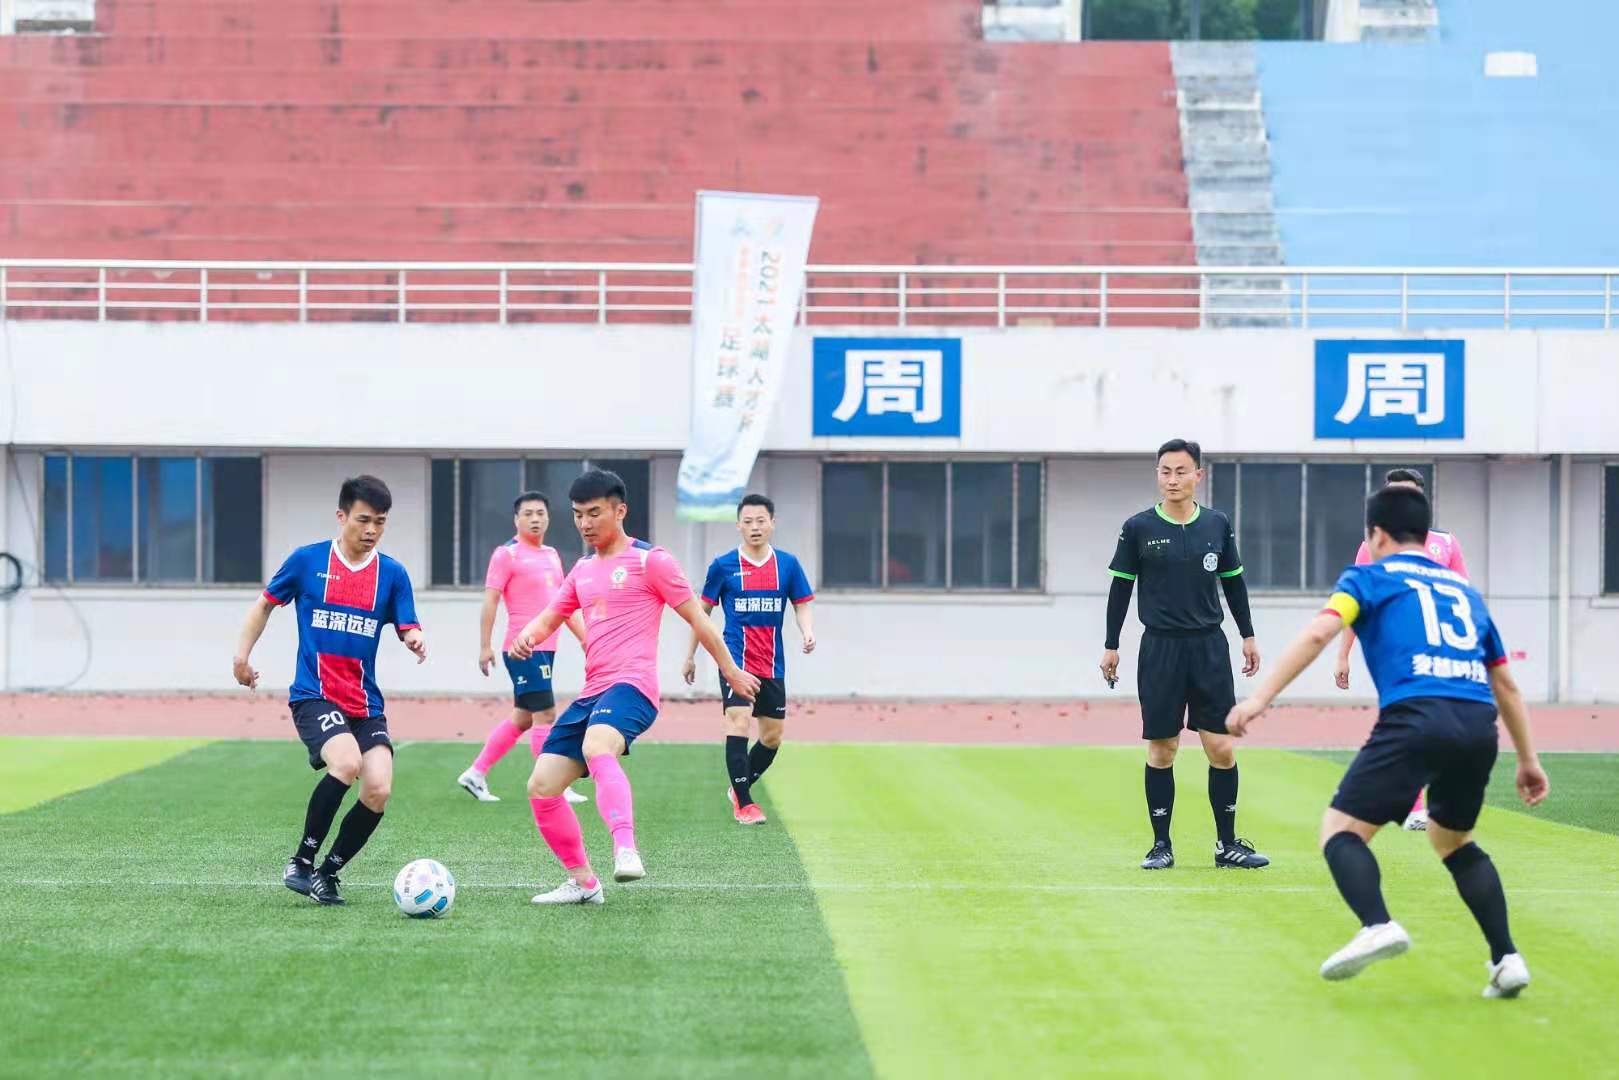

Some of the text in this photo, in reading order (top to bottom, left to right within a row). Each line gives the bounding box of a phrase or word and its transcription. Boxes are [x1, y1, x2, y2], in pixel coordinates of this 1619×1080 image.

[832, 349, 943, 423] 周
[1334, 352, 1445, 426] 周
[311, 608, 378, 638] 蓝深远望
[1404, 578, 1478, 651] 13
[317, 710, 345, 732] 20
